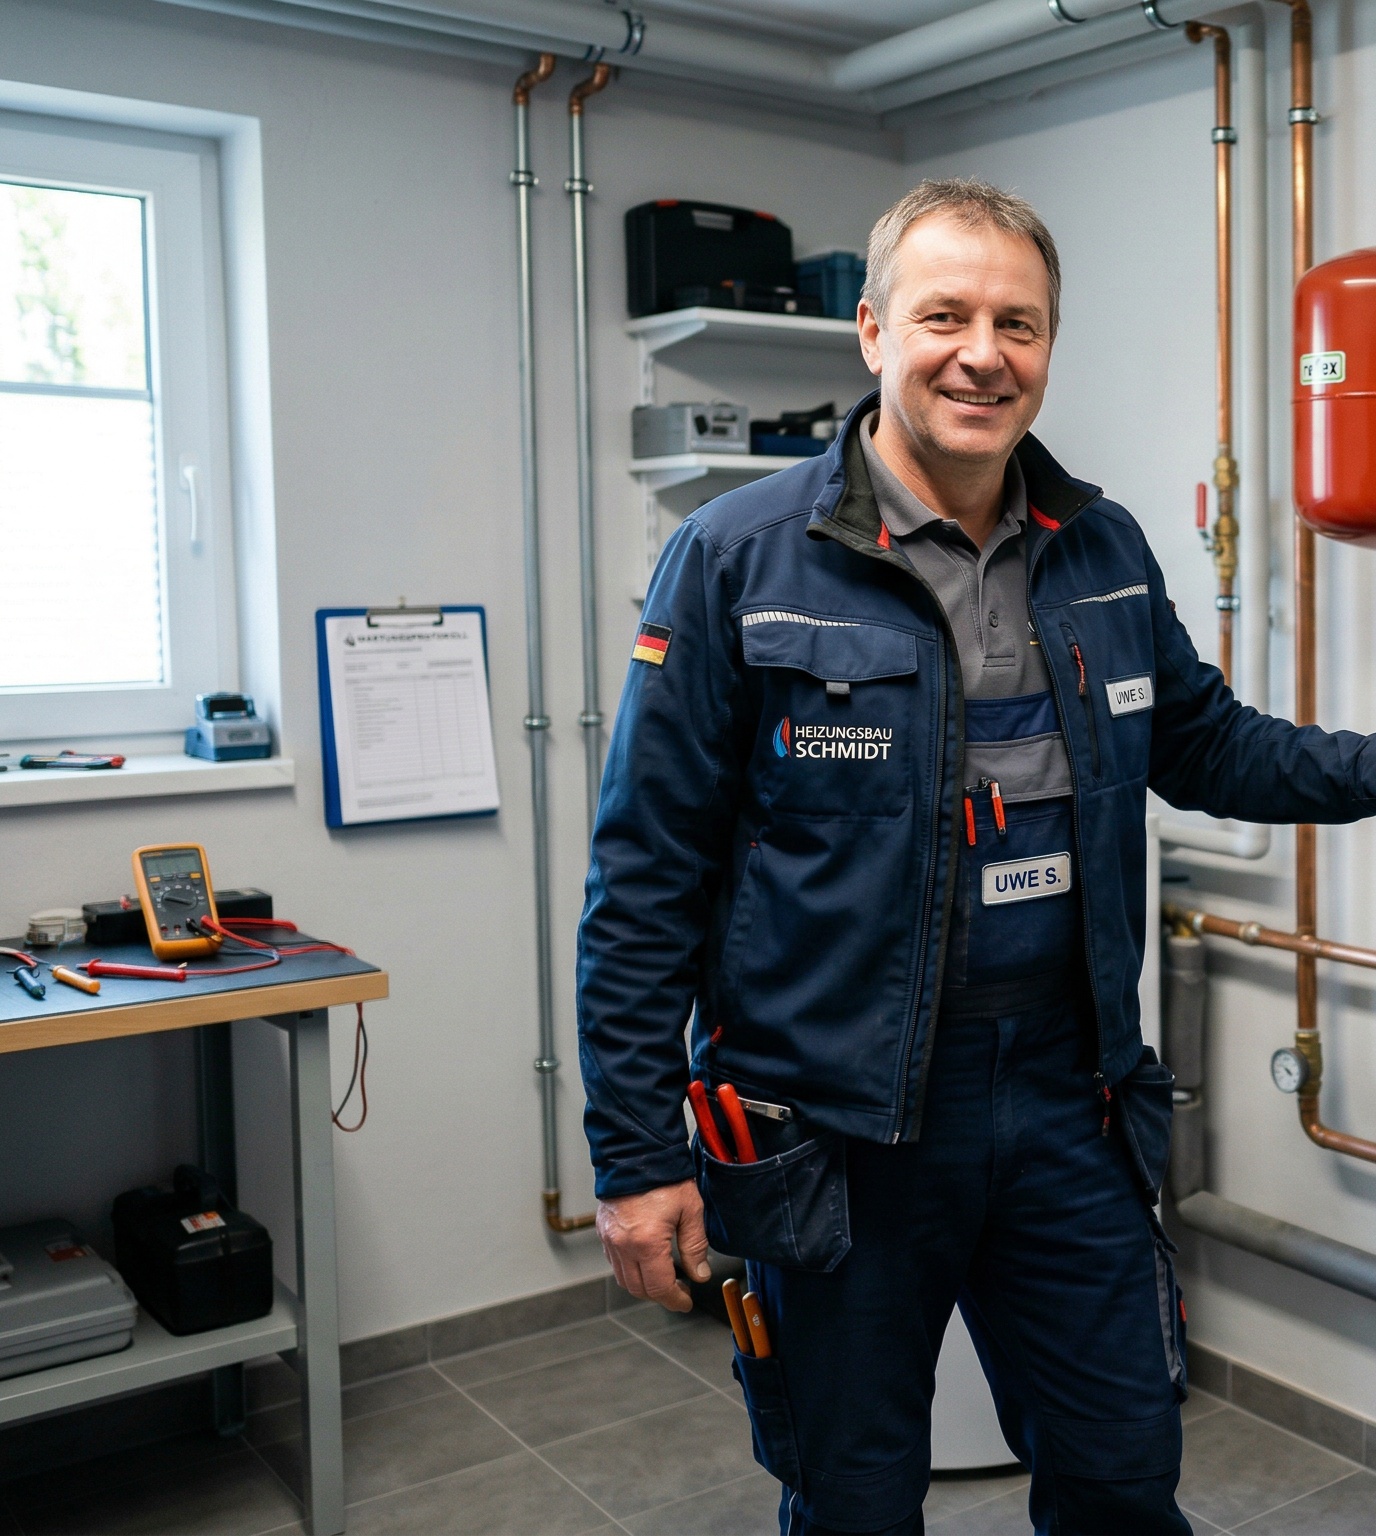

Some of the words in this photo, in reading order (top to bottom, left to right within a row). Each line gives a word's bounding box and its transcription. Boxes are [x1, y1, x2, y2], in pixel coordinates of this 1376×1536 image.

[1115, 688, 1137, 705] UWE
[795, 726, 892, 740] HEIZUNGSBAU
[796, 741, 892, 760] SCHMIDT
[995, 869, 1039, 892] UWE
[1045, 867, 1061, 884] S.
